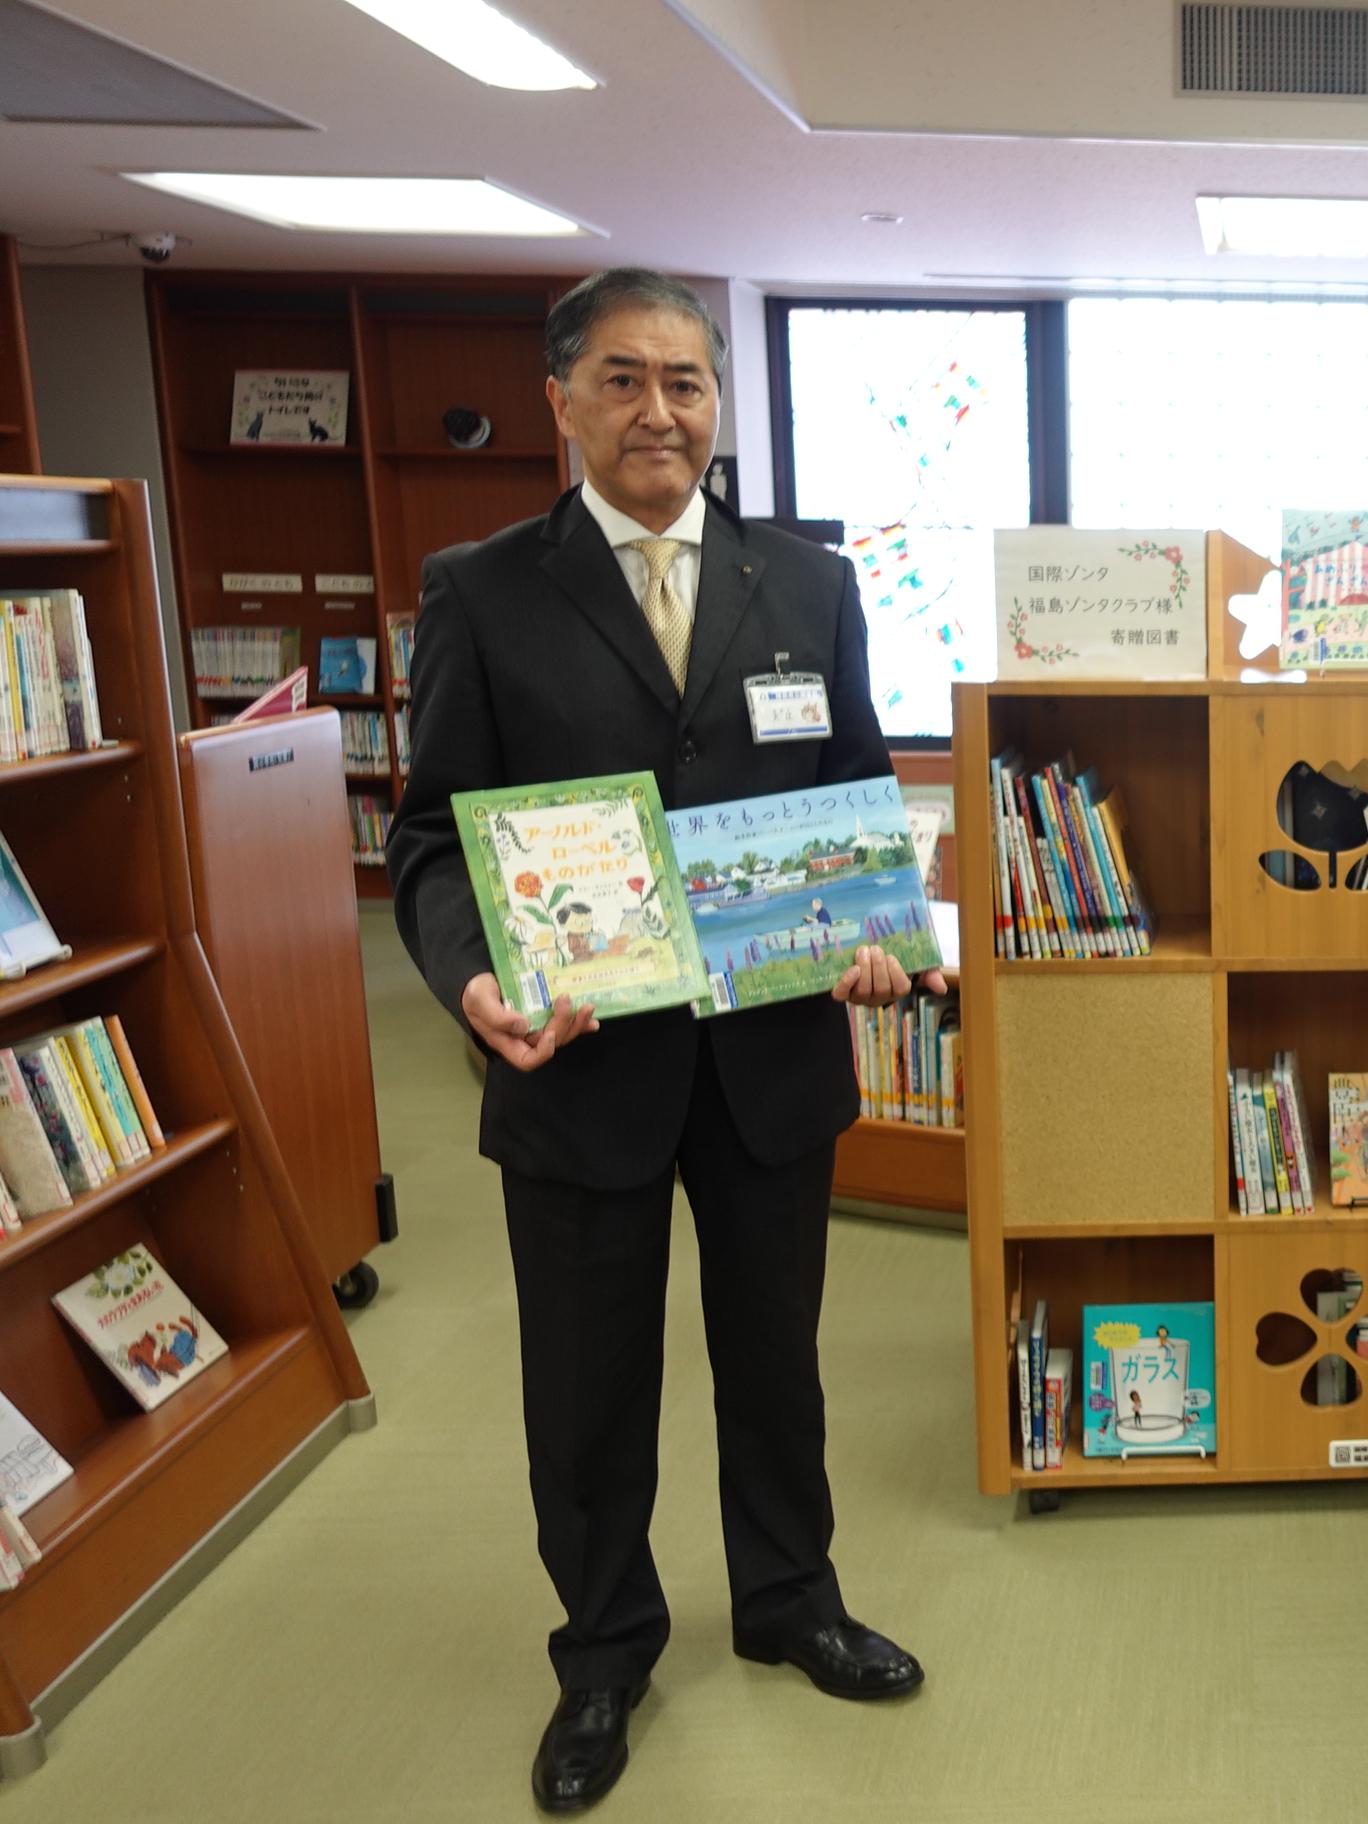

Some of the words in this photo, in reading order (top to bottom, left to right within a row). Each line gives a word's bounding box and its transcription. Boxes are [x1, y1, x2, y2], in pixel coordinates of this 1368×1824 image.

[1028, 564, 1109, 583] 国際ゾンタ
[1029, 596, 1175, 615] 福島ゾンタクラブ様
[1111, 628, 1180, 646] 寄贈図書
[551, 838, 618, 861] ローベル
[542, 856, 629, 881] ものがたり
[1121, 1353, 1180, 1384] ガラス
